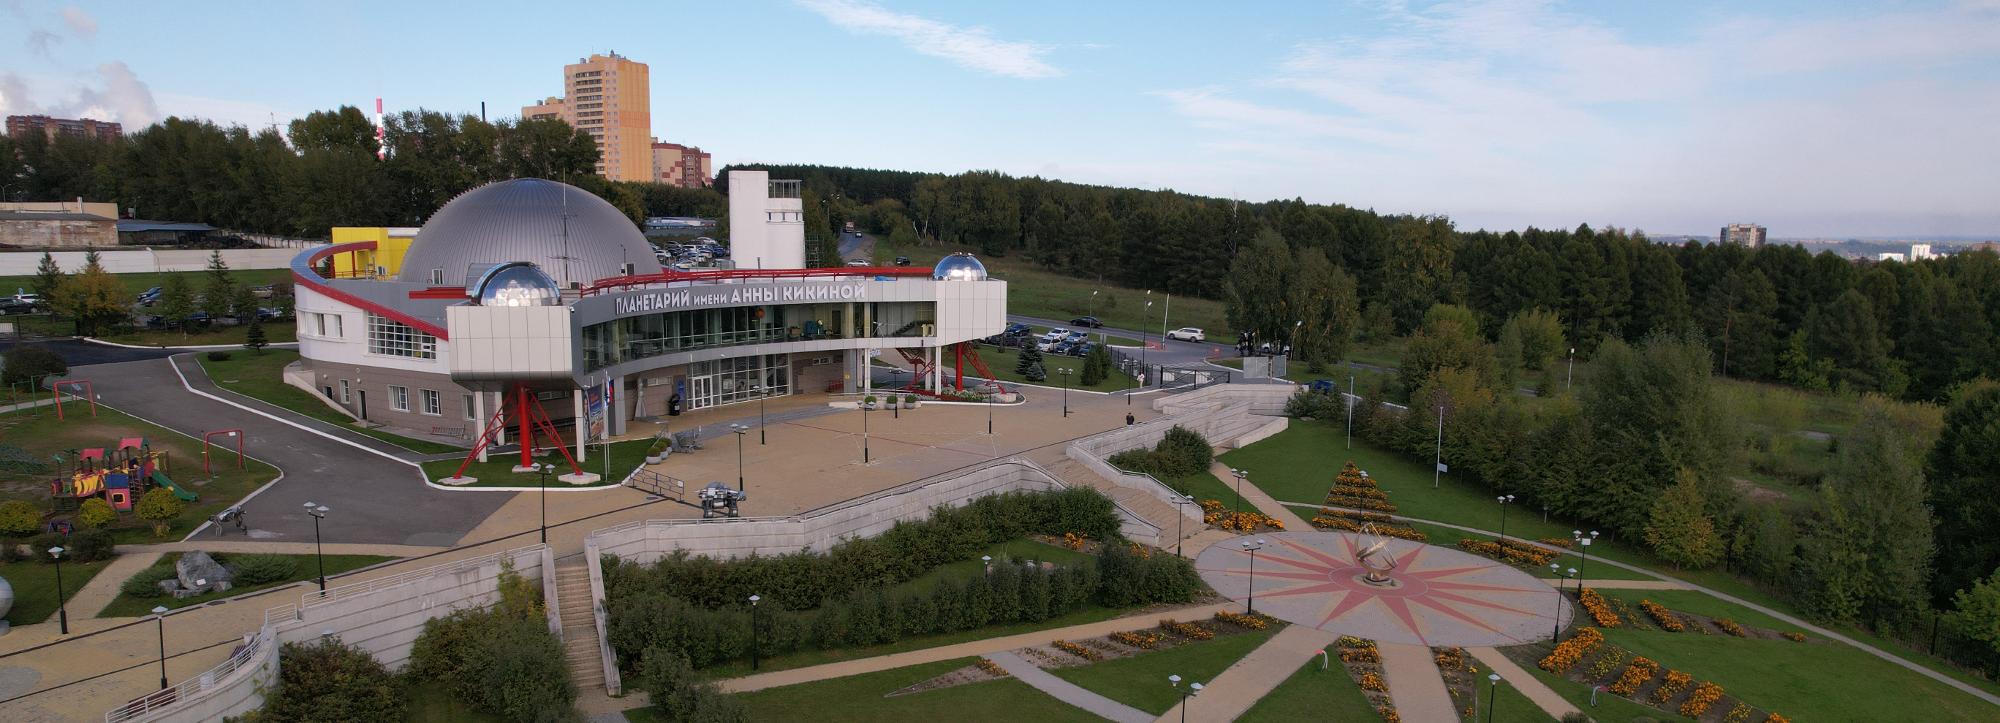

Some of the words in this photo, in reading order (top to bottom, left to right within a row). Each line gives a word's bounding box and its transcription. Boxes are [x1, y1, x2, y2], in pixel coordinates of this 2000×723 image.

[616, 289, 690, 315] ПЛАНЕТАРИЙ
[693, 293, 727, 306] ИМЕНИ
[730, 287, 778, 303] АННЫ
[783, 281, 865, 301] КИКИНОЙ
